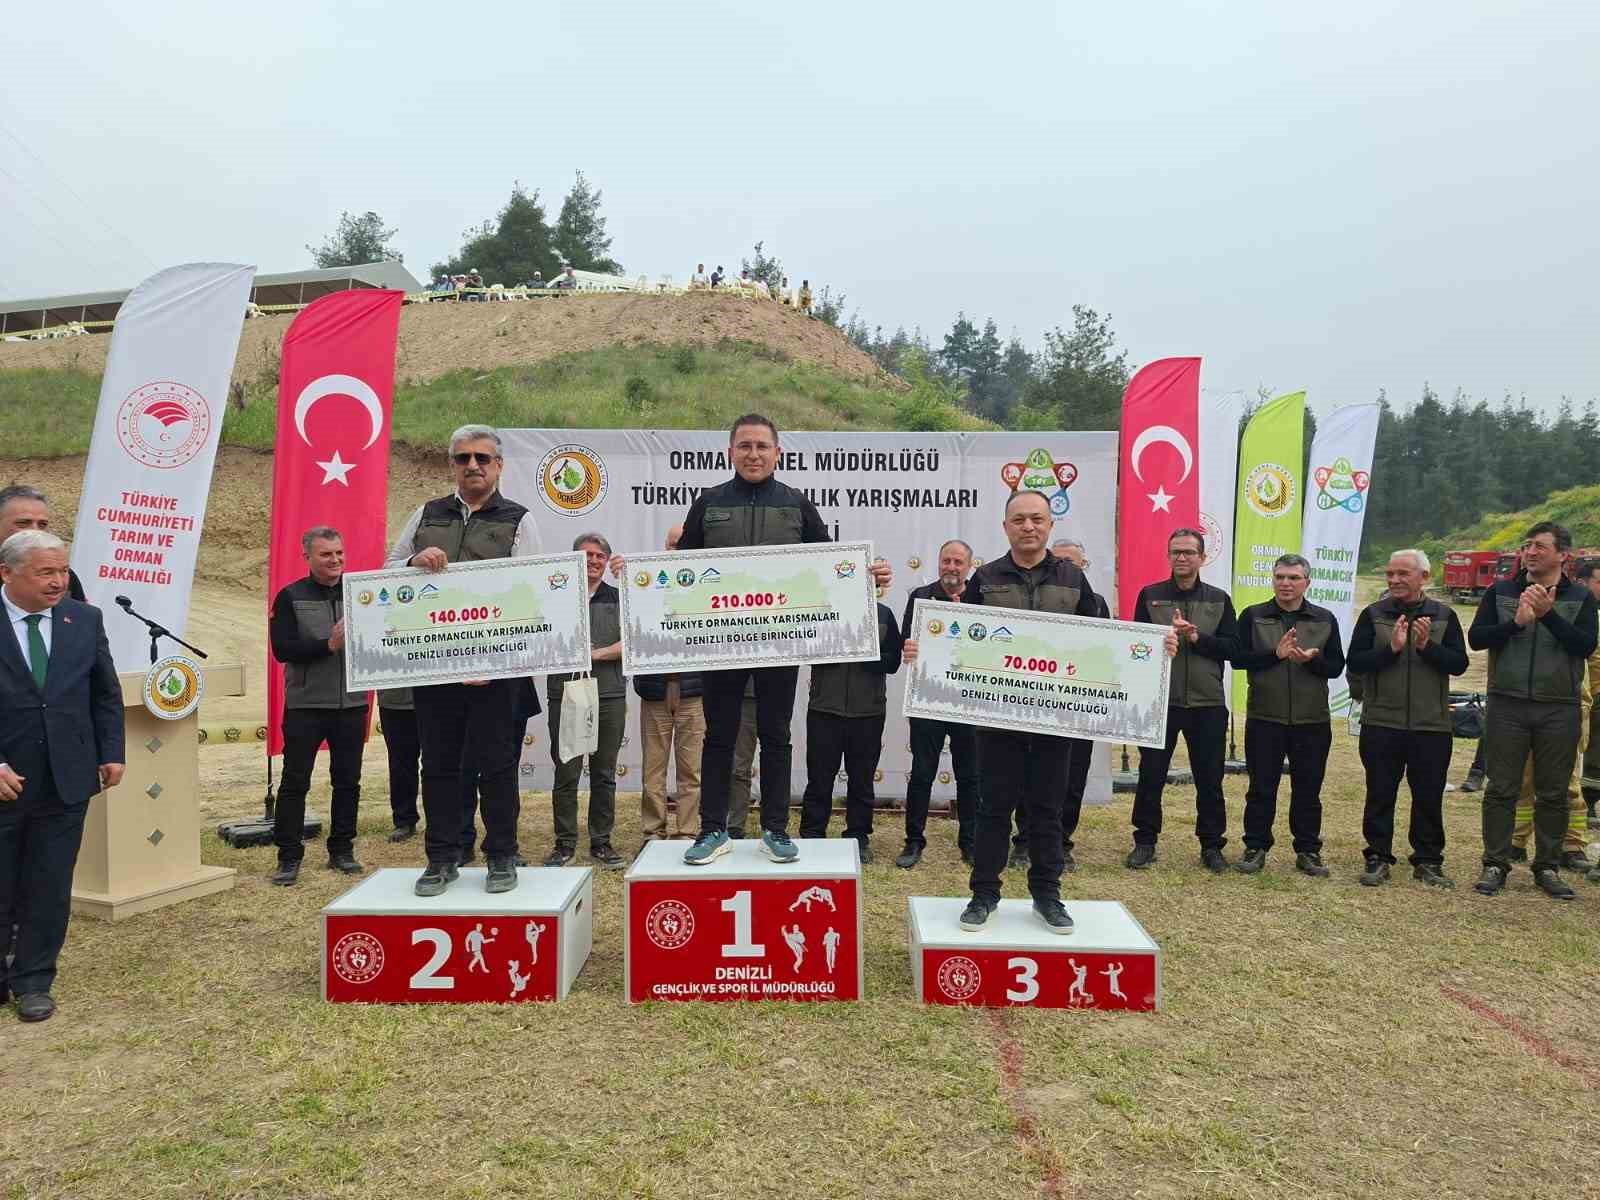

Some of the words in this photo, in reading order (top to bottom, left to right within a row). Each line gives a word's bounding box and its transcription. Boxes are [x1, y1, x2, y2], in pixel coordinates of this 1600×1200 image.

[670, 451, 734, 470] ORMA
[815, 448, 939, 472] MÜDÜRLÜĞÜ
[121, 490, 178, 511] TÜRKİYE
[632, 482, 708, 506] TÜRKİY
[847, 489, 978, 512] YARIŞMALARI
[97, 508, 194, 531] CUMHURİYETİ
[111, 529, 153, 545] TARIM
[158, 534, 174, 548] VE
[115, 548, 163, 565] ORMAN
[98, 565, 172, 585] BAKANLIĞI
[711, 592, 774, 608] 210.000
[429, 606, 489, 624] 140.000
[706, 614, 770, 629] ORMANCILIK
[424, 629, 485, 644] ORMANCILIK
[1004, 655, 1057, 674] 70.000
[990, 676, 1054, 692] ORMANCILIK
[721, 890, 766, 957] 1
[409, 928, 455, 989] 2
[715, 964, 772, 980] DENİZLİ
[1006, 957, 1040, 1002] 3
[653, 981, 701, 997] GENÇLİK
[702, 983, 717, 993] VE
[717, 983, 748, 994] SPOR
[749, 981, 760, 994] İL
[762, 981, 836, 994] MÜDÜRLÜĞÜ
